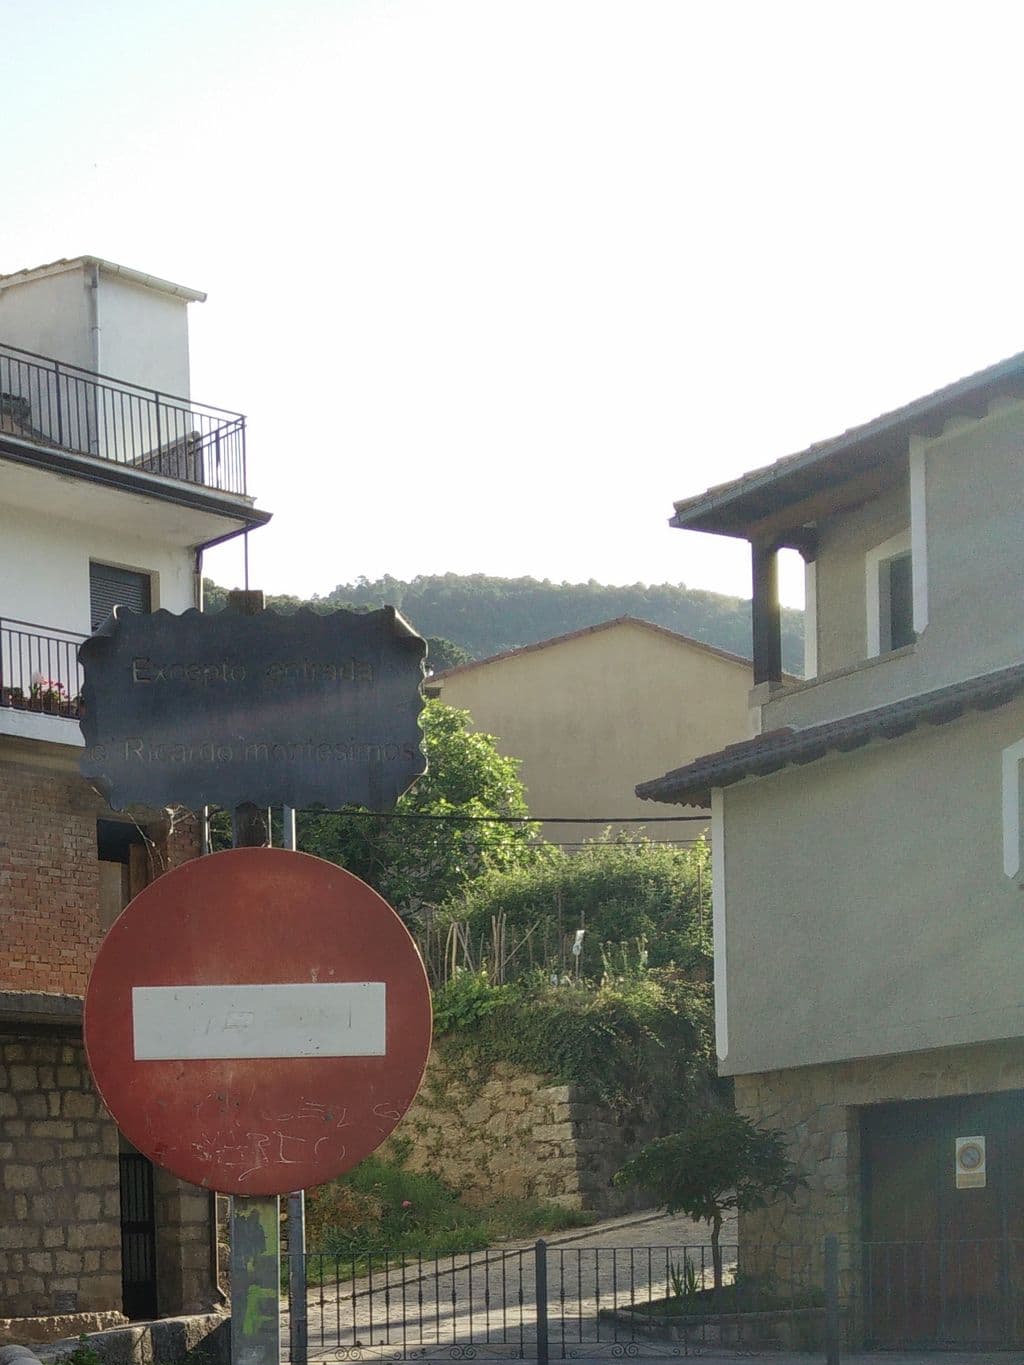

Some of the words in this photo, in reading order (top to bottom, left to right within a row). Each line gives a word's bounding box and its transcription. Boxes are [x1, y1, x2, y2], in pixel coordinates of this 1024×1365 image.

[131, 656, 247, 686] Excepto
[265, 656, 373, 682] entrada
[124, 737, 234, 763] Ricardo
